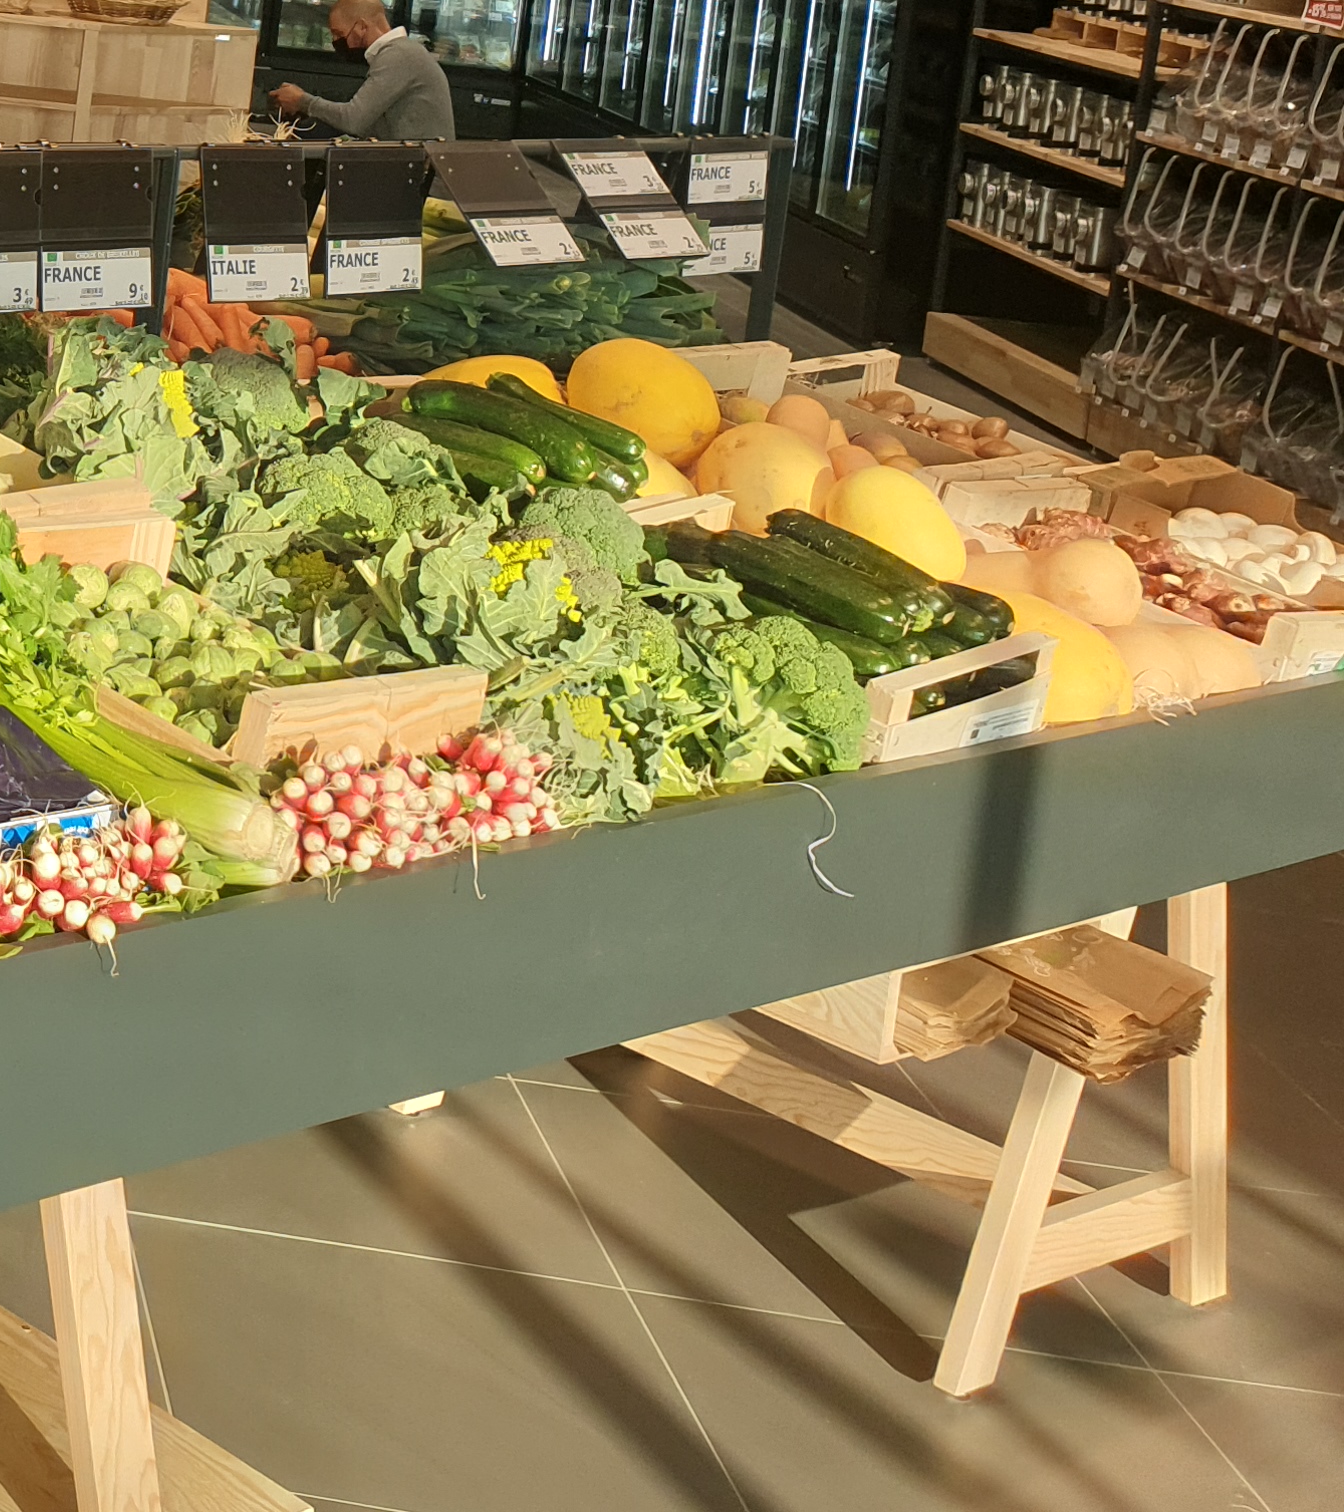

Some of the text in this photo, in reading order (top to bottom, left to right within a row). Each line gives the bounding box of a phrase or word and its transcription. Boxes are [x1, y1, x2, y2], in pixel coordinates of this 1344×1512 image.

[571, 162, 618, 176] FRANCE
[691, 166, 732, 181] FRANCE
[480, 229, 532, 244] FRANCE
[610, 223, 658, 238] FRANCE
[559, 242, 571, 256] 2
[211, 259, 257, 276] ITALIE
[329, 251, 379, 269] FRANCE
[44, 265, 102, 284] FRANCE
[402, 267, 410, 283] 2
[129, 283, 138, 299] 9
[290, 277, 299, 292] 2
[13, 287, 22, 303] 3
